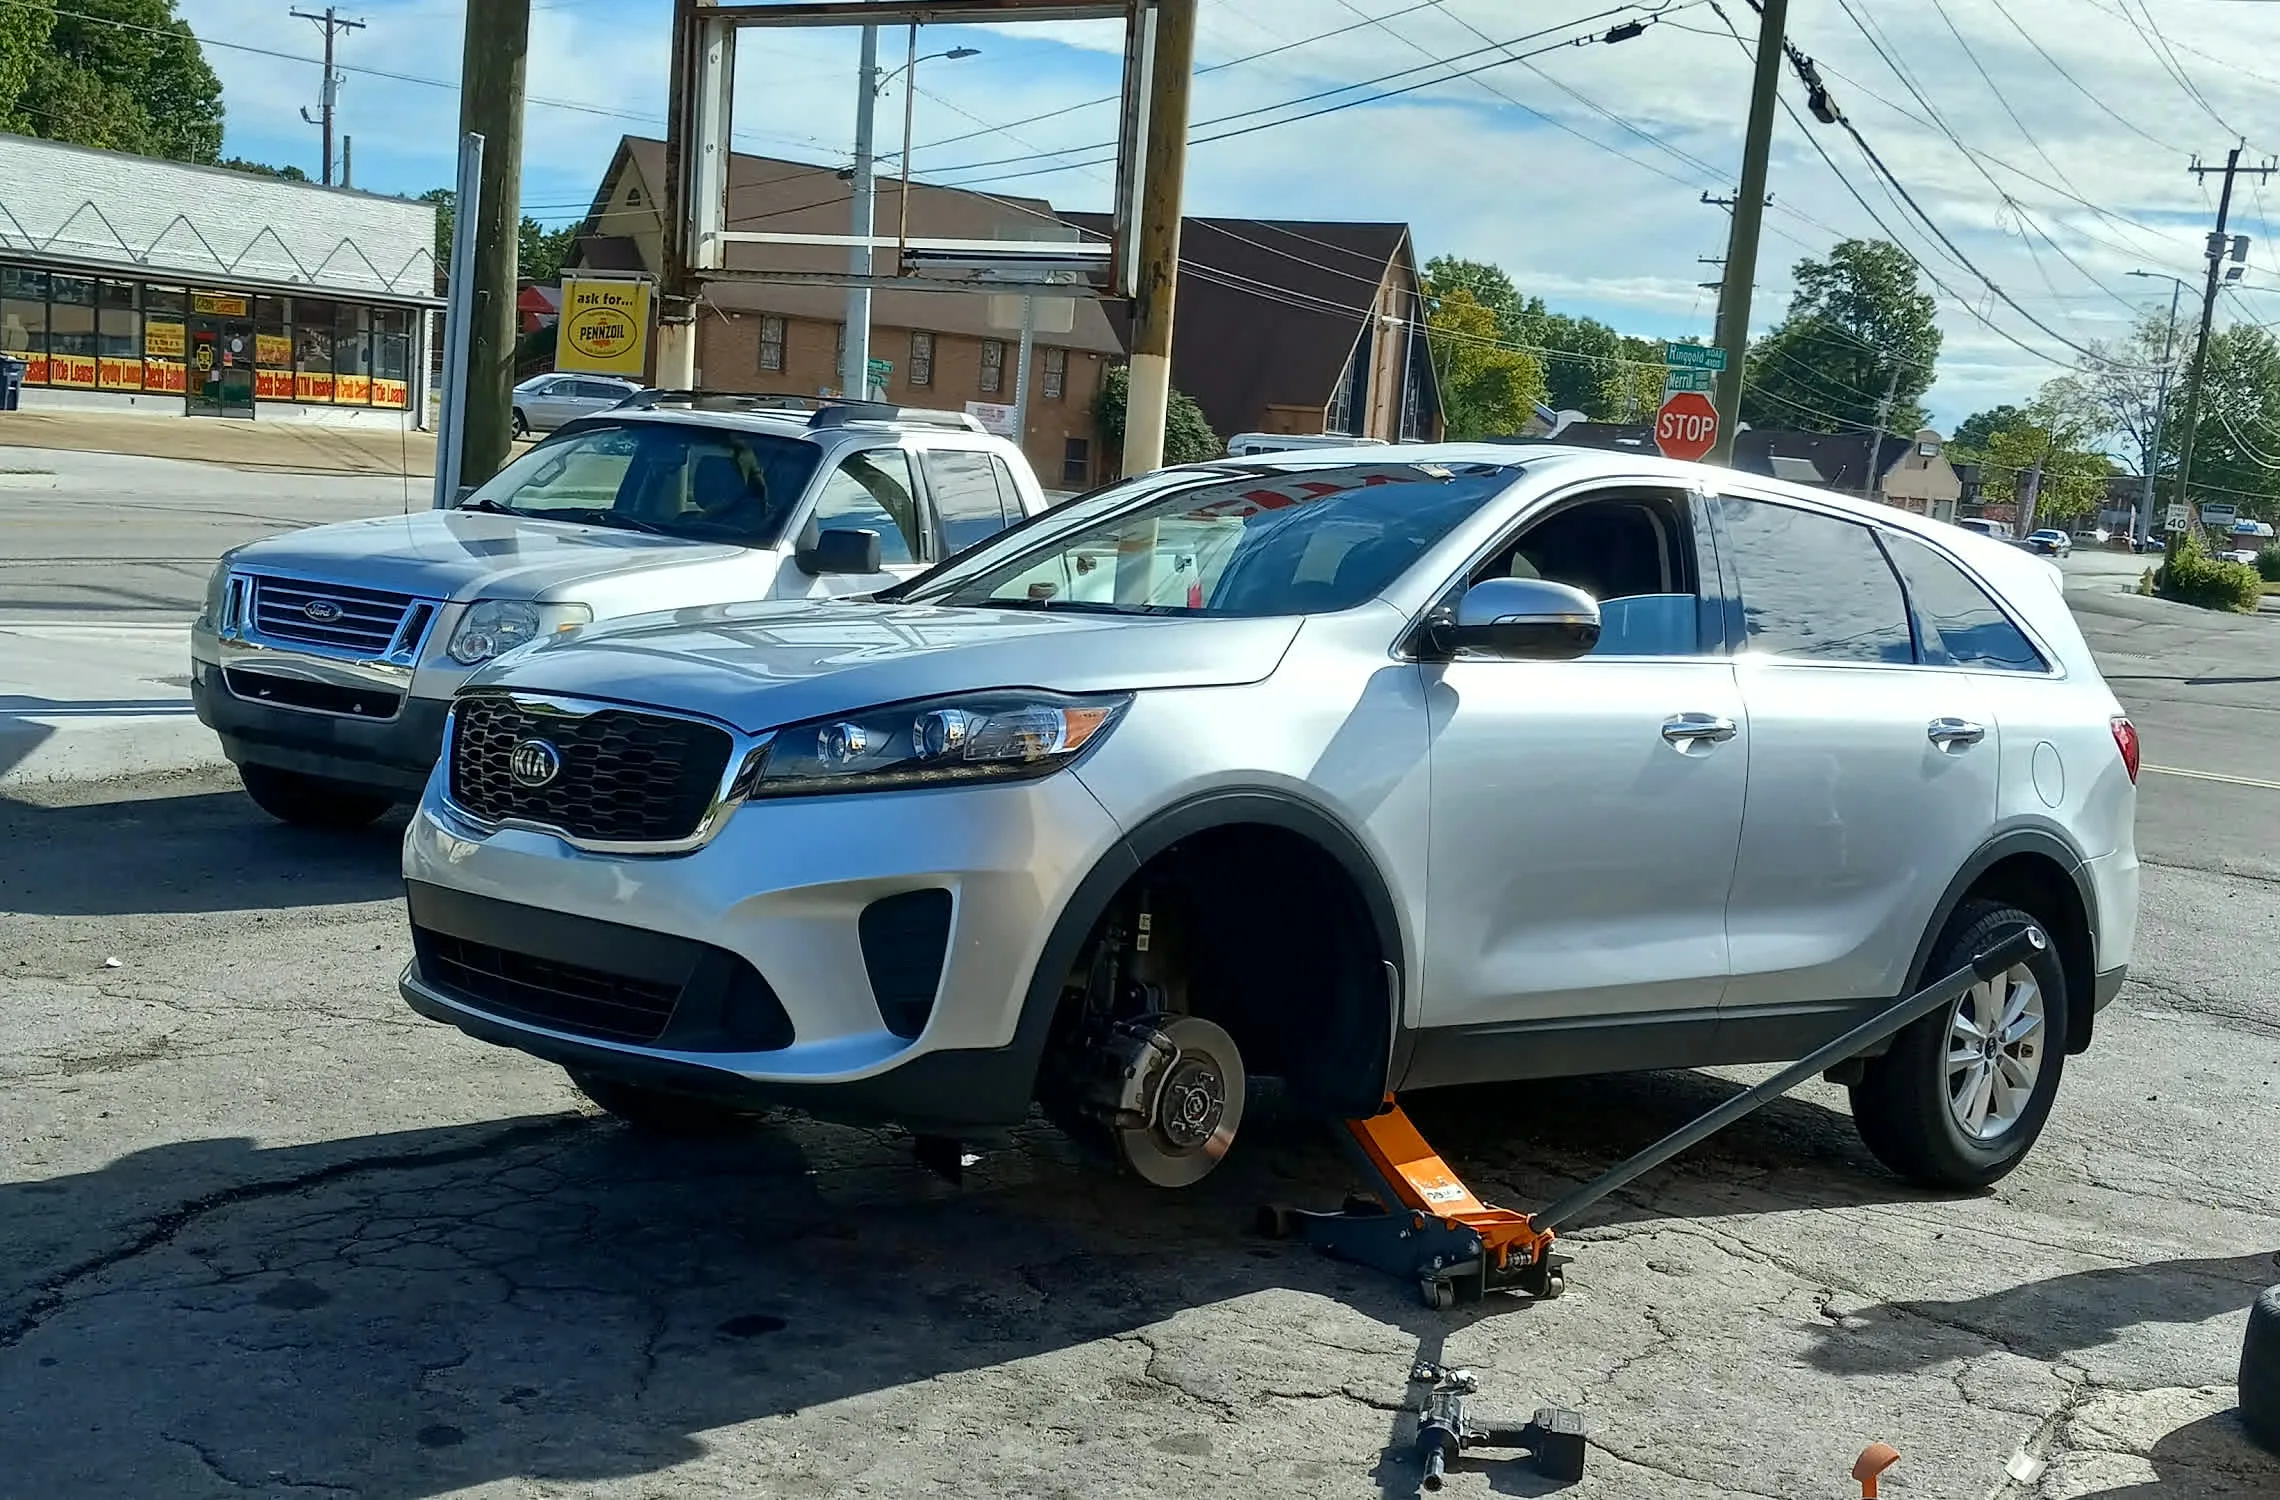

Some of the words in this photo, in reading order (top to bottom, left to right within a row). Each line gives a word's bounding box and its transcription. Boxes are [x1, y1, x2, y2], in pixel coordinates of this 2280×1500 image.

[577, 293, 600, 304] ask
[602, 293, 633, 306] for...
[580, 325, 625, 341] PENNZOIL
[1669, 344, 1705, 365] Ringgold
[1660, 413, 1715, 442] STOP
[2168, 519, 2186, 529] 40
[307, 603, 332, 617] Ford
[514, 749, 548, 777] KIA
